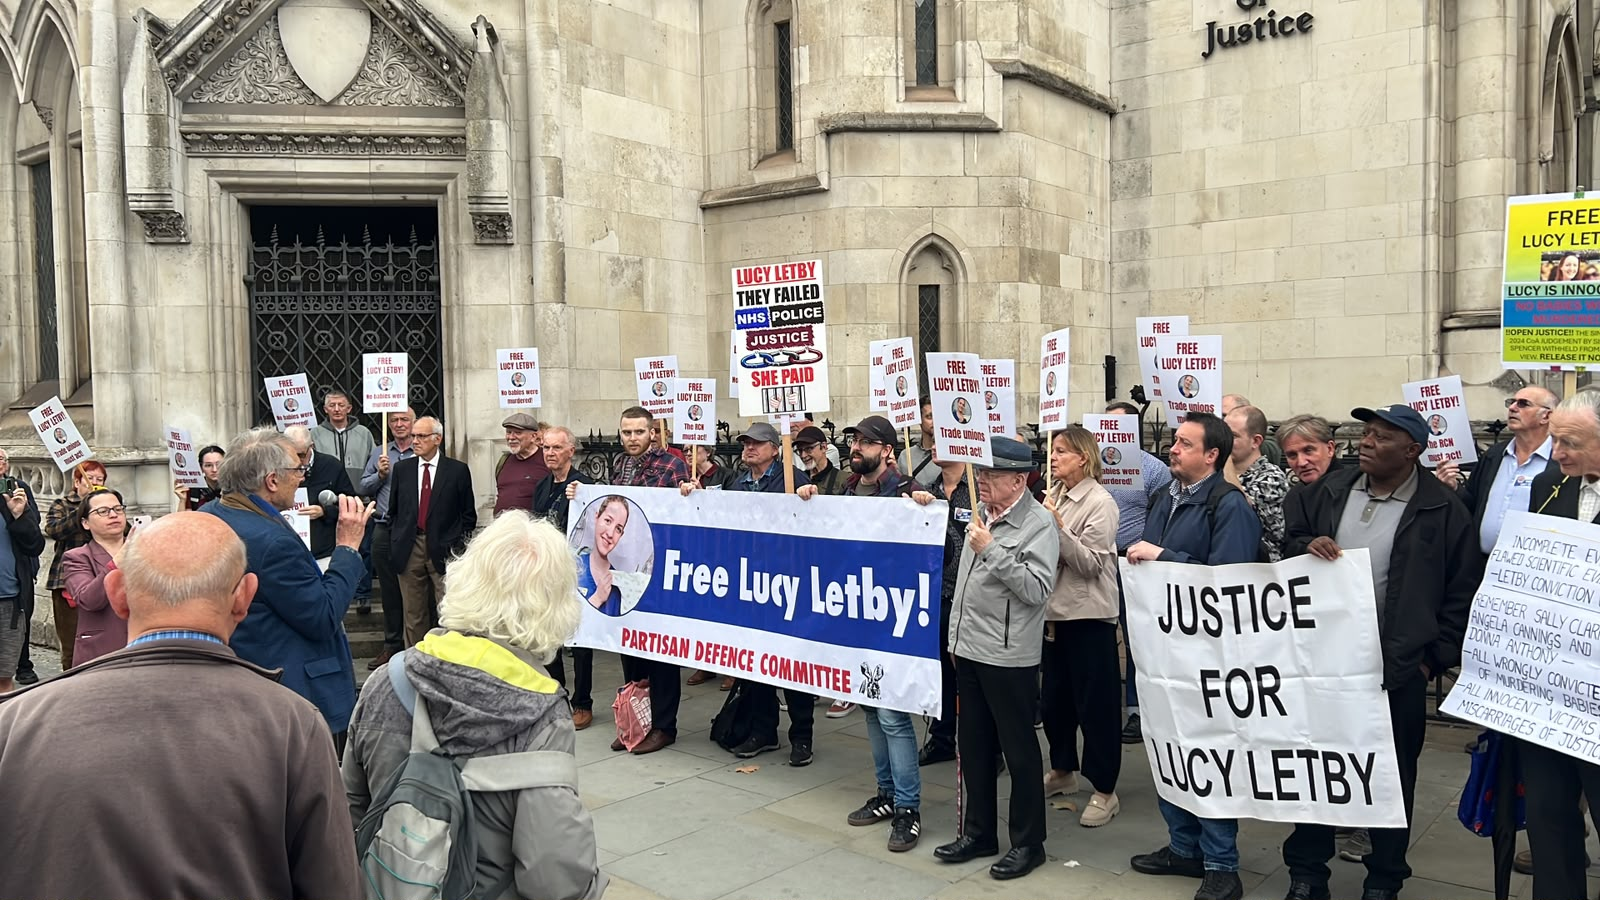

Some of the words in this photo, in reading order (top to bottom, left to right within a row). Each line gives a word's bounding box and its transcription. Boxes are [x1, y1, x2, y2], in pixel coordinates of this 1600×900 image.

[1201, 9, 1314, 59] Justice
[1548, 208, 1600, 226] FREE
[1522, 234, 1565, 248] LUCY
[736, 266, 771, 284] LUCY
[775, 262, 816, 280] LETBY
[736, 288, 770, 307] THEY
[774, 284, 819, 303] FAILED
[1508, 286, 1540, 296] LUCY
[1545, 285, 1557, 296] IS
[1516, 301, 1534, 310] NO
[1537, 301, 1582, 310] BABIES
[737, 313, 766, 324] NHS
[772, 307, 822, 321] POLICE
[1153, 323, 1170, 333] FREE
[751, 332, 809, 346] JUSTICE
[1047, 338, 1057, 352] FREE
[892, 347, 904, 359] FREE
[1177, 343, 1198, 354] FREE
[510, 352, 524, 360] FREE
[1050, 352, 1065, 366] LETBY!
[367, 366, 381, 374] LUCY
[384, 366, 404, 374] LETBY!
[500, 362, 514, 370] LUCY
[516, 362, 535, 370] LETBY!
[650, 361, 664, 369] FREE
[885, 362, 896, 375] LUCY
[898, 358, 913, 372] LETBY!
[947, 361, 966, 374] FREE
[1162, 358, 1182, 370] LUCY
[1186, 358, 1216, 370] LETBY!
[639, 371, 654, 380] LUCY
[656, 370, 675, 378] LETBY!
[751, 370, 779, 387] SHE
[781, 367, 814, 384] PAID
[279, 379, 293, 387] FREE
[689, 383, 702, 391] FREE
[934, 378, 954, 391] LUCY
[957, 379, 980, 393] LETBY!
[986, 377, 1010, 387] LETBY!
[286, 386, 306, 395] LETBY!
[1420, 385, 1440, 398] FREE
[677, 393, 692, 402] LUCY
[694, 394, 712, 402] LETBY!
[1056, 399, 1065, 407] were
[1430, 396, 1460, 410] LETBY!
[890, 401, 902, 411] Trade
[903, 398, 916, 408] unions
[1168, 401, 1187, 410] Trade
[1189, 402, 1214, 413] unions
[41, 406, 54, 418] FREE
[895, 414, 906, 423] must
[907, 412, 915, 420] act!
[989, 413, 1000, 421] RCN
[38, 420, 52, 432] LUCY
[50, 411, 66, 426] LETBY!
[1100, 420, 1118, 430] FREE
[940, 427, 960, 438] Trade
[963, 429, 985, 442] unions
[993, 425, 1004, 433] act!
[171, 432, 181, 440] FREE
[1108, 433, 1135, 443] LETBY!
[54, 448, 67, 458] Trade
[66, 440, 81, 452] unions
[176, 442, 192, 451] LETBY!
[1427, 440, 1437, 448] he
[1439, 438, 1454, 447] RCN
[949, 445, 968, 455] must
[970, 446, 982, 458] act!
[1428, 452, 1443, 461] must
[1445, 450, 1462, 460] act!
[64, 456, 75, 464] must
[1513, 535, 1578, 559] INCOMPLETE
[1491, 549, 1525, 565] FLAWED
[1526, 556, 1579, 577] SCIENTIFIC
[662, 549, 729, 598] Free
[739, 556, 800, 622] Lucy
[811, 565, 930, 638] Letby!
[1531, 576, 1594, 604] CONVICTION
[1158, 576, 1316, 638] JUSTICE
[1475, 593, 1527, 619] REMEMBER
[1534, 609, 1568, 629] SALLY
[1569, 618, 1600, 640] CLAR
[1471, 610, 1508, 633] ANGELA
[1513, 623, 1561, 650] CANNINGS
[1569, 639, 1591, 656] AND
[1469, 627, 1500, 648] DONNA
[1506, 639, 1558, 665] ANTHONY
[621, 627, 690, 660] PARTISAN
[694, 640, 754, 673] DEFENCE
[760, 652, 851, 694] COMMITTEE
[1493, 654, 1542, 680] WRONGLY
[1200, 664, 1287, 719] FOR
[1479, 668, 1491, 680] OF
[1496, 673, 1553, 706] MURDERING
[1484, 688, 1541, 715] INNOCENT
[1549, 709, 1597, 735] VICTIMS
[1457, 700, 1536, 735] MISCARRIAGES
[1539, 727, 1557, 741] OF
[1558, 732, 1600, 759] JUSTIC
[1152, 738, 1235, 798] LUCY
[1246, 749, 1375, 806] LETBY
